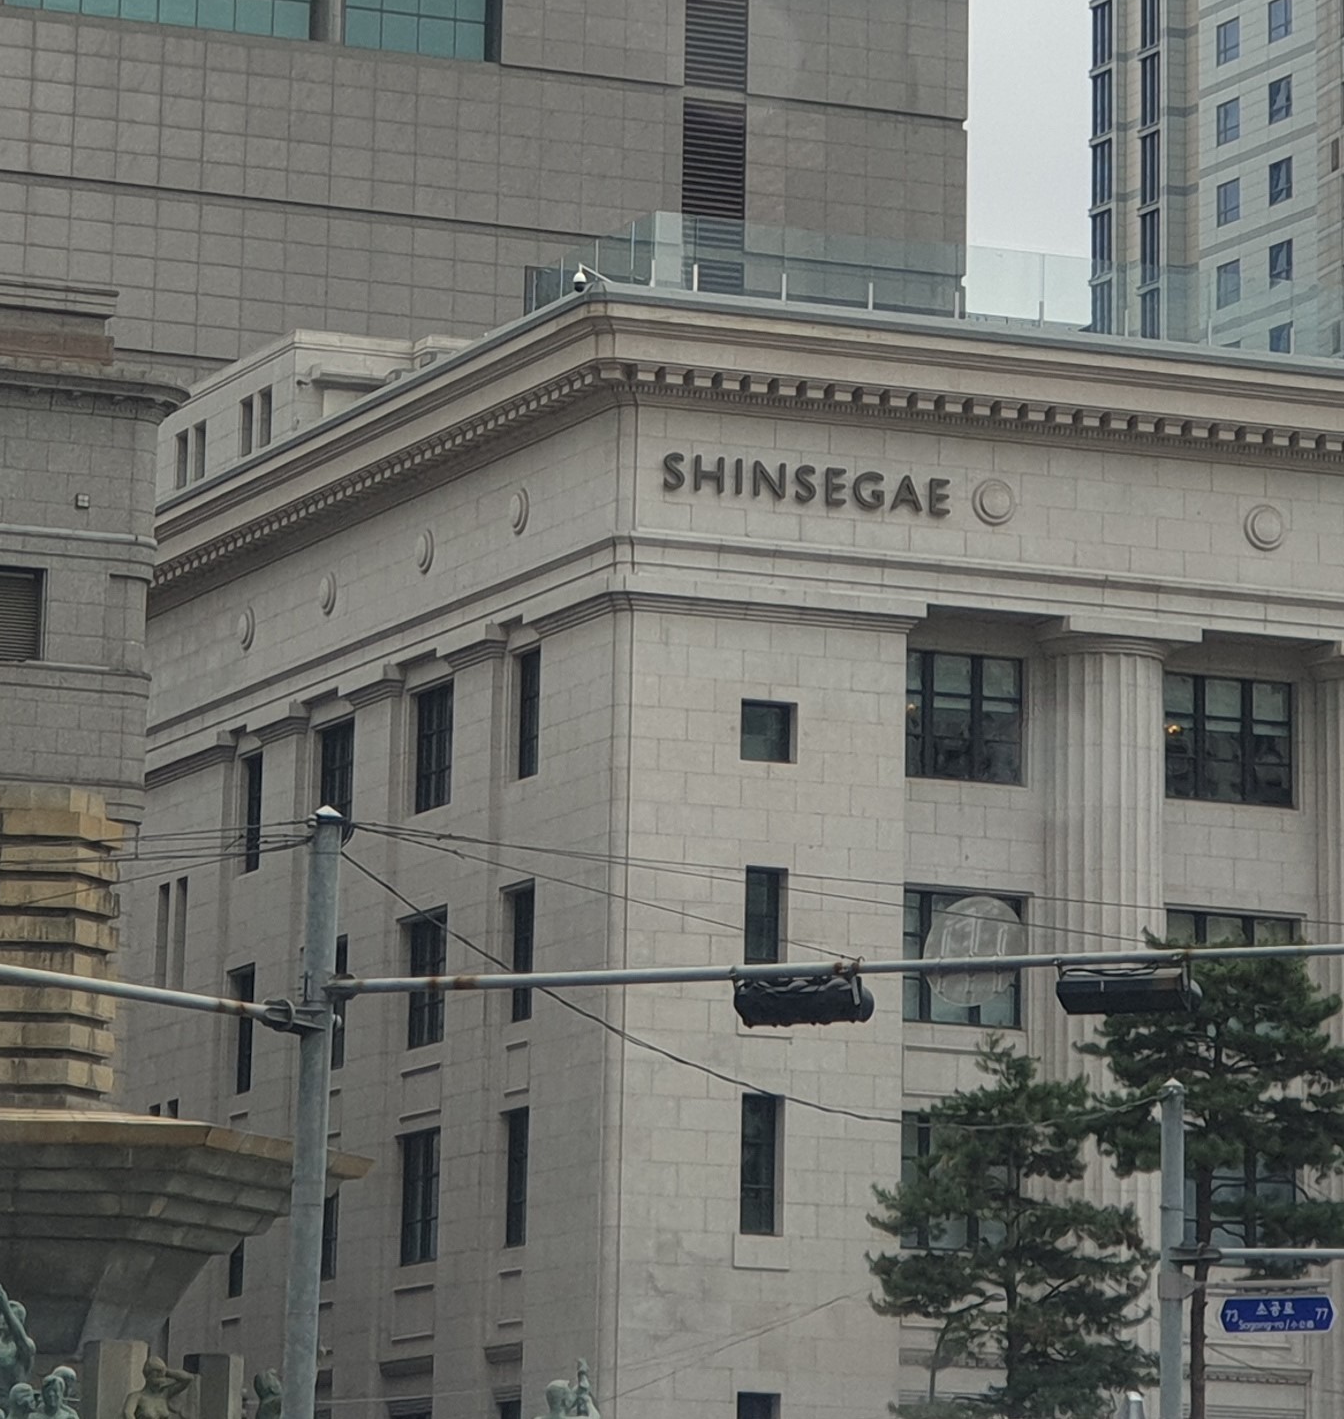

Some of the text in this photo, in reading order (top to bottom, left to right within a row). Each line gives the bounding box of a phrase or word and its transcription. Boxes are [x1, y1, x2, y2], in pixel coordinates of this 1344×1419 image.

[662, 451, 952, 518] SHINSEGAE
[1255, 1301, 1295, 1317] 소공로
[1314, 1307, 1329, 1321] 77
